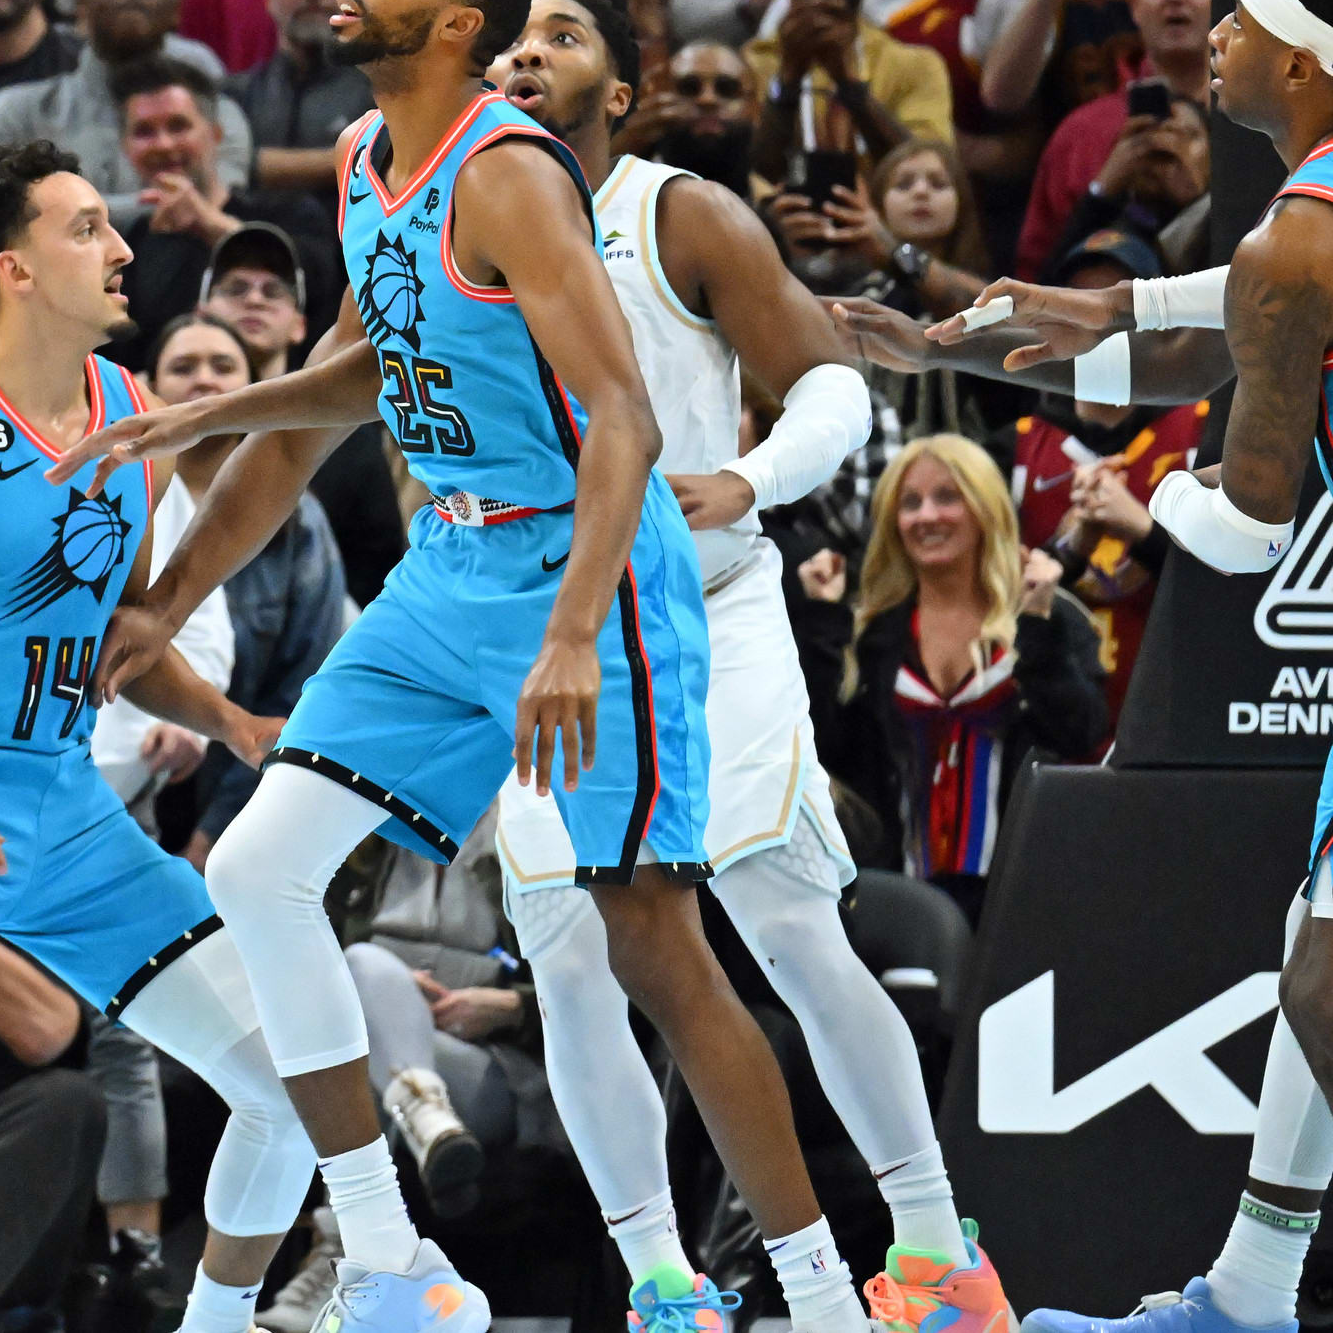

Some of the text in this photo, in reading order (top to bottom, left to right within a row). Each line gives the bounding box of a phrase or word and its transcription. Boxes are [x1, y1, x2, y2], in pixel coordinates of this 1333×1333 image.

[408, 215, 441, 235] PayPal
[605, 249, 634, 261] IFFS
[381, 350, 477, 457] 25
[11, 635, 97, 741] 14
[1270, 666, 1333, 699] AV
